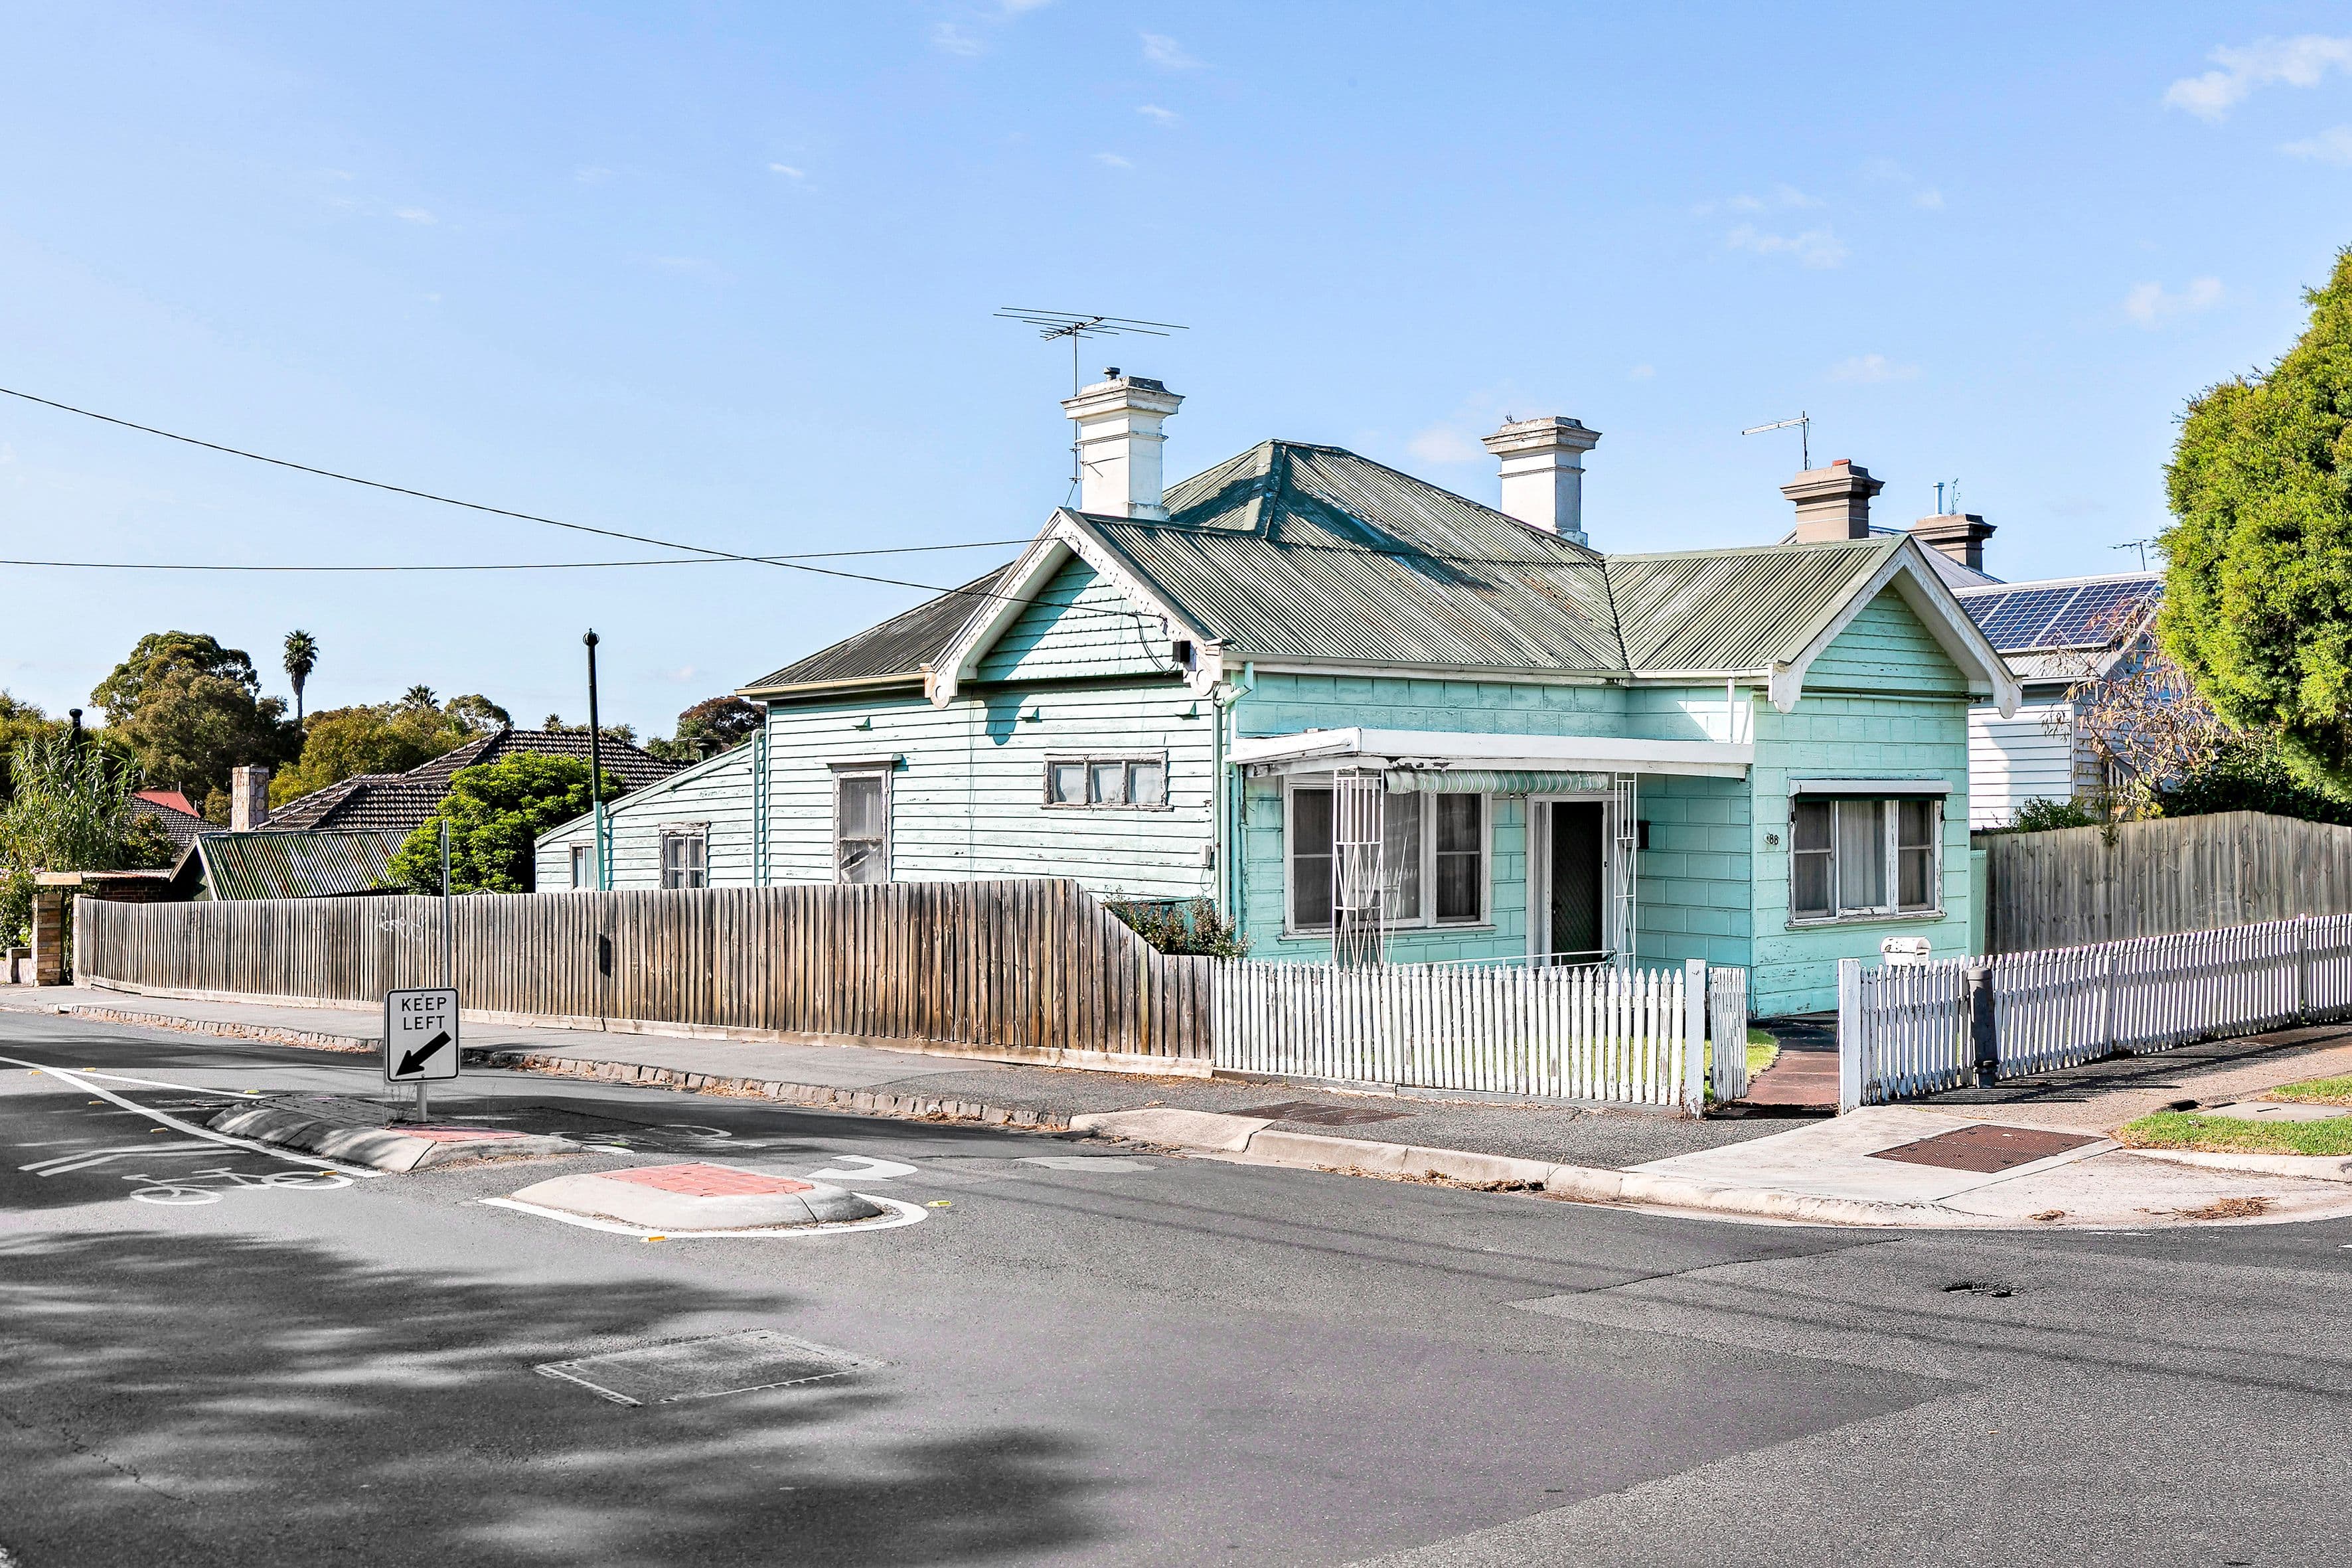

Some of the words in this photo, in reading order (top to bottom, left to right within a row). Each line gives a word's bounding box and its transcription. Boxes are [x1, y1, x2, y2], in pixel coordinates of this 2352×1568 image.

[1769, 834, 1779, 845] 88
[402, 997, 447, 1012] KEEP
[403, 1016, 445, 1030] LEFT
